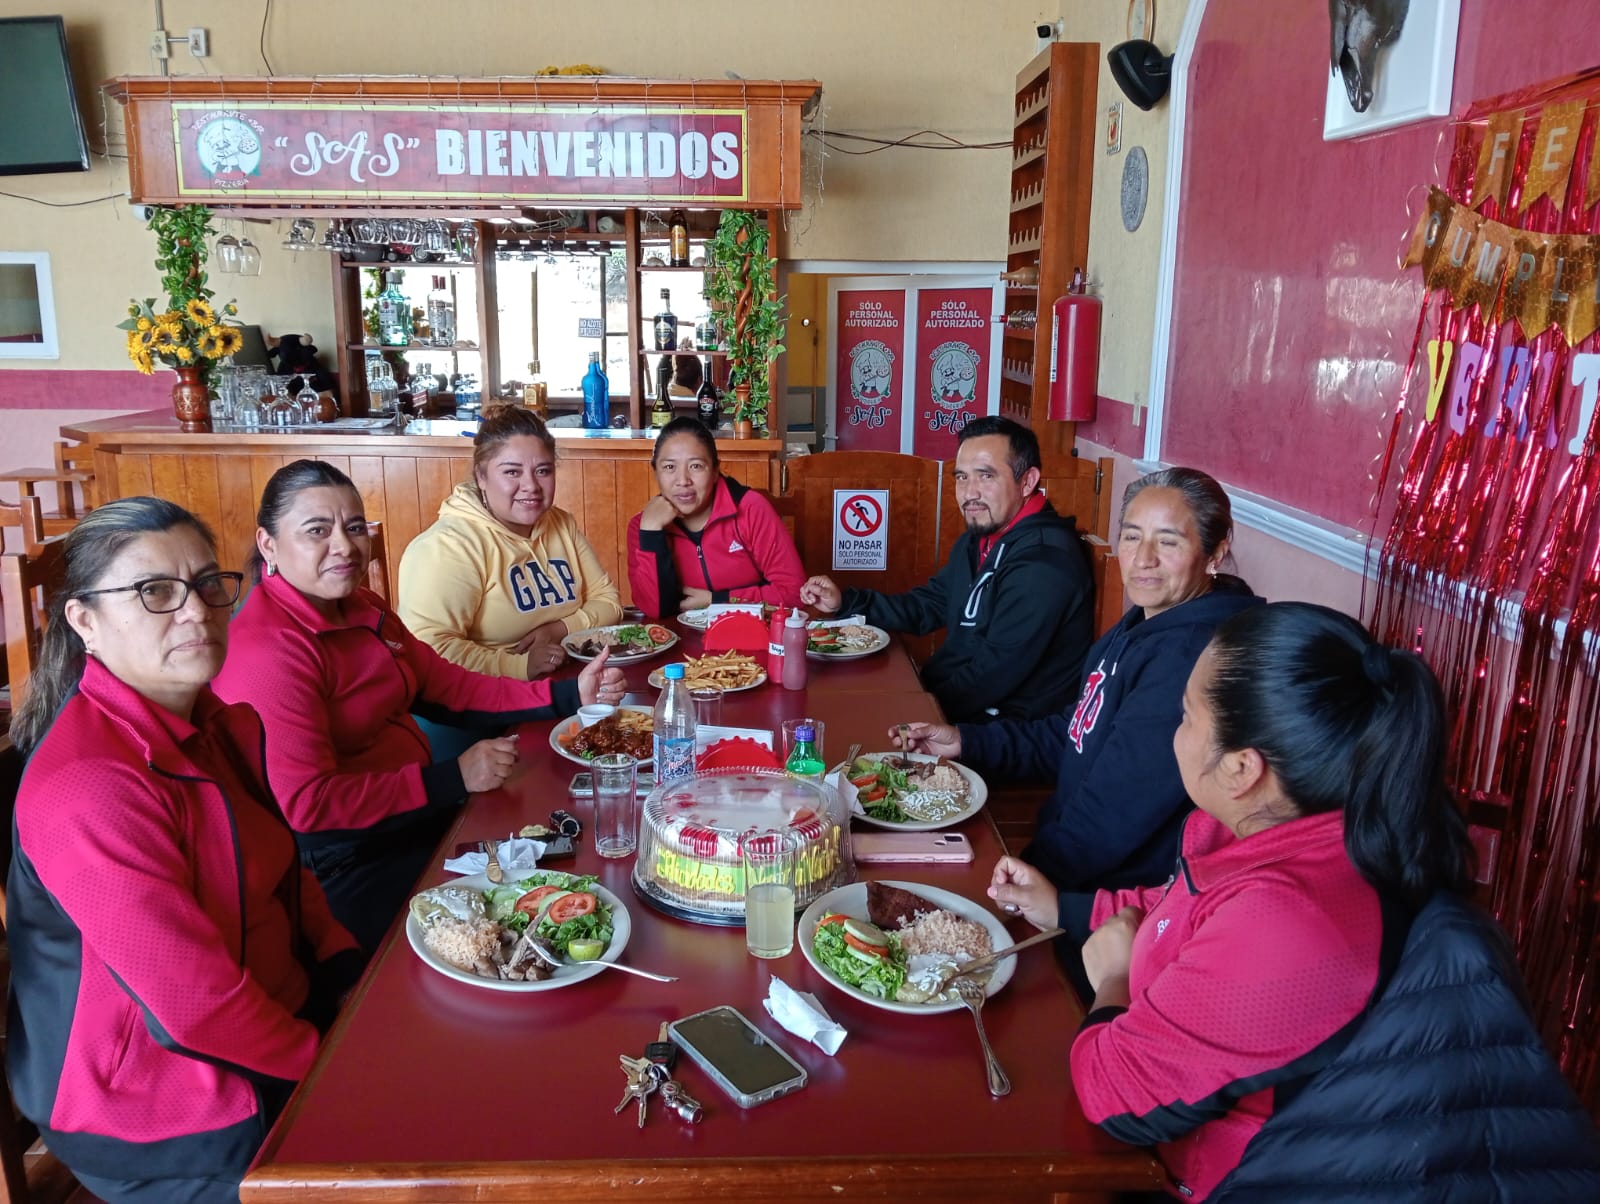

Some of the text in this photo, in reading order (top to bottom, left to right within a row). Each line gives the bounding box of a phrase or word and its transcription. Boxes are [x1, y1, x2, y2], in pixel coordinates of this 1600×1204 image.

[435, 129, 740, 180] BIENVENIDOS
[1424, 210, 1600, 304] CUMPL
[859, 300, 882, 310] SÓLO
[941, 300, 966, 310] SÓLO
[849, 310, 894, 319] PERSONAL
[931, 310, 980, 319] PERSONAL
[845, 319, 899, 328] AUTORIZADO
[925, 319, 985, 328] AUTORIZADO
[838, 540, 882, 550] NO PASAR
[853, 550, 882, 558] PERSONAL
[509, 558, 577, 614] GAP
